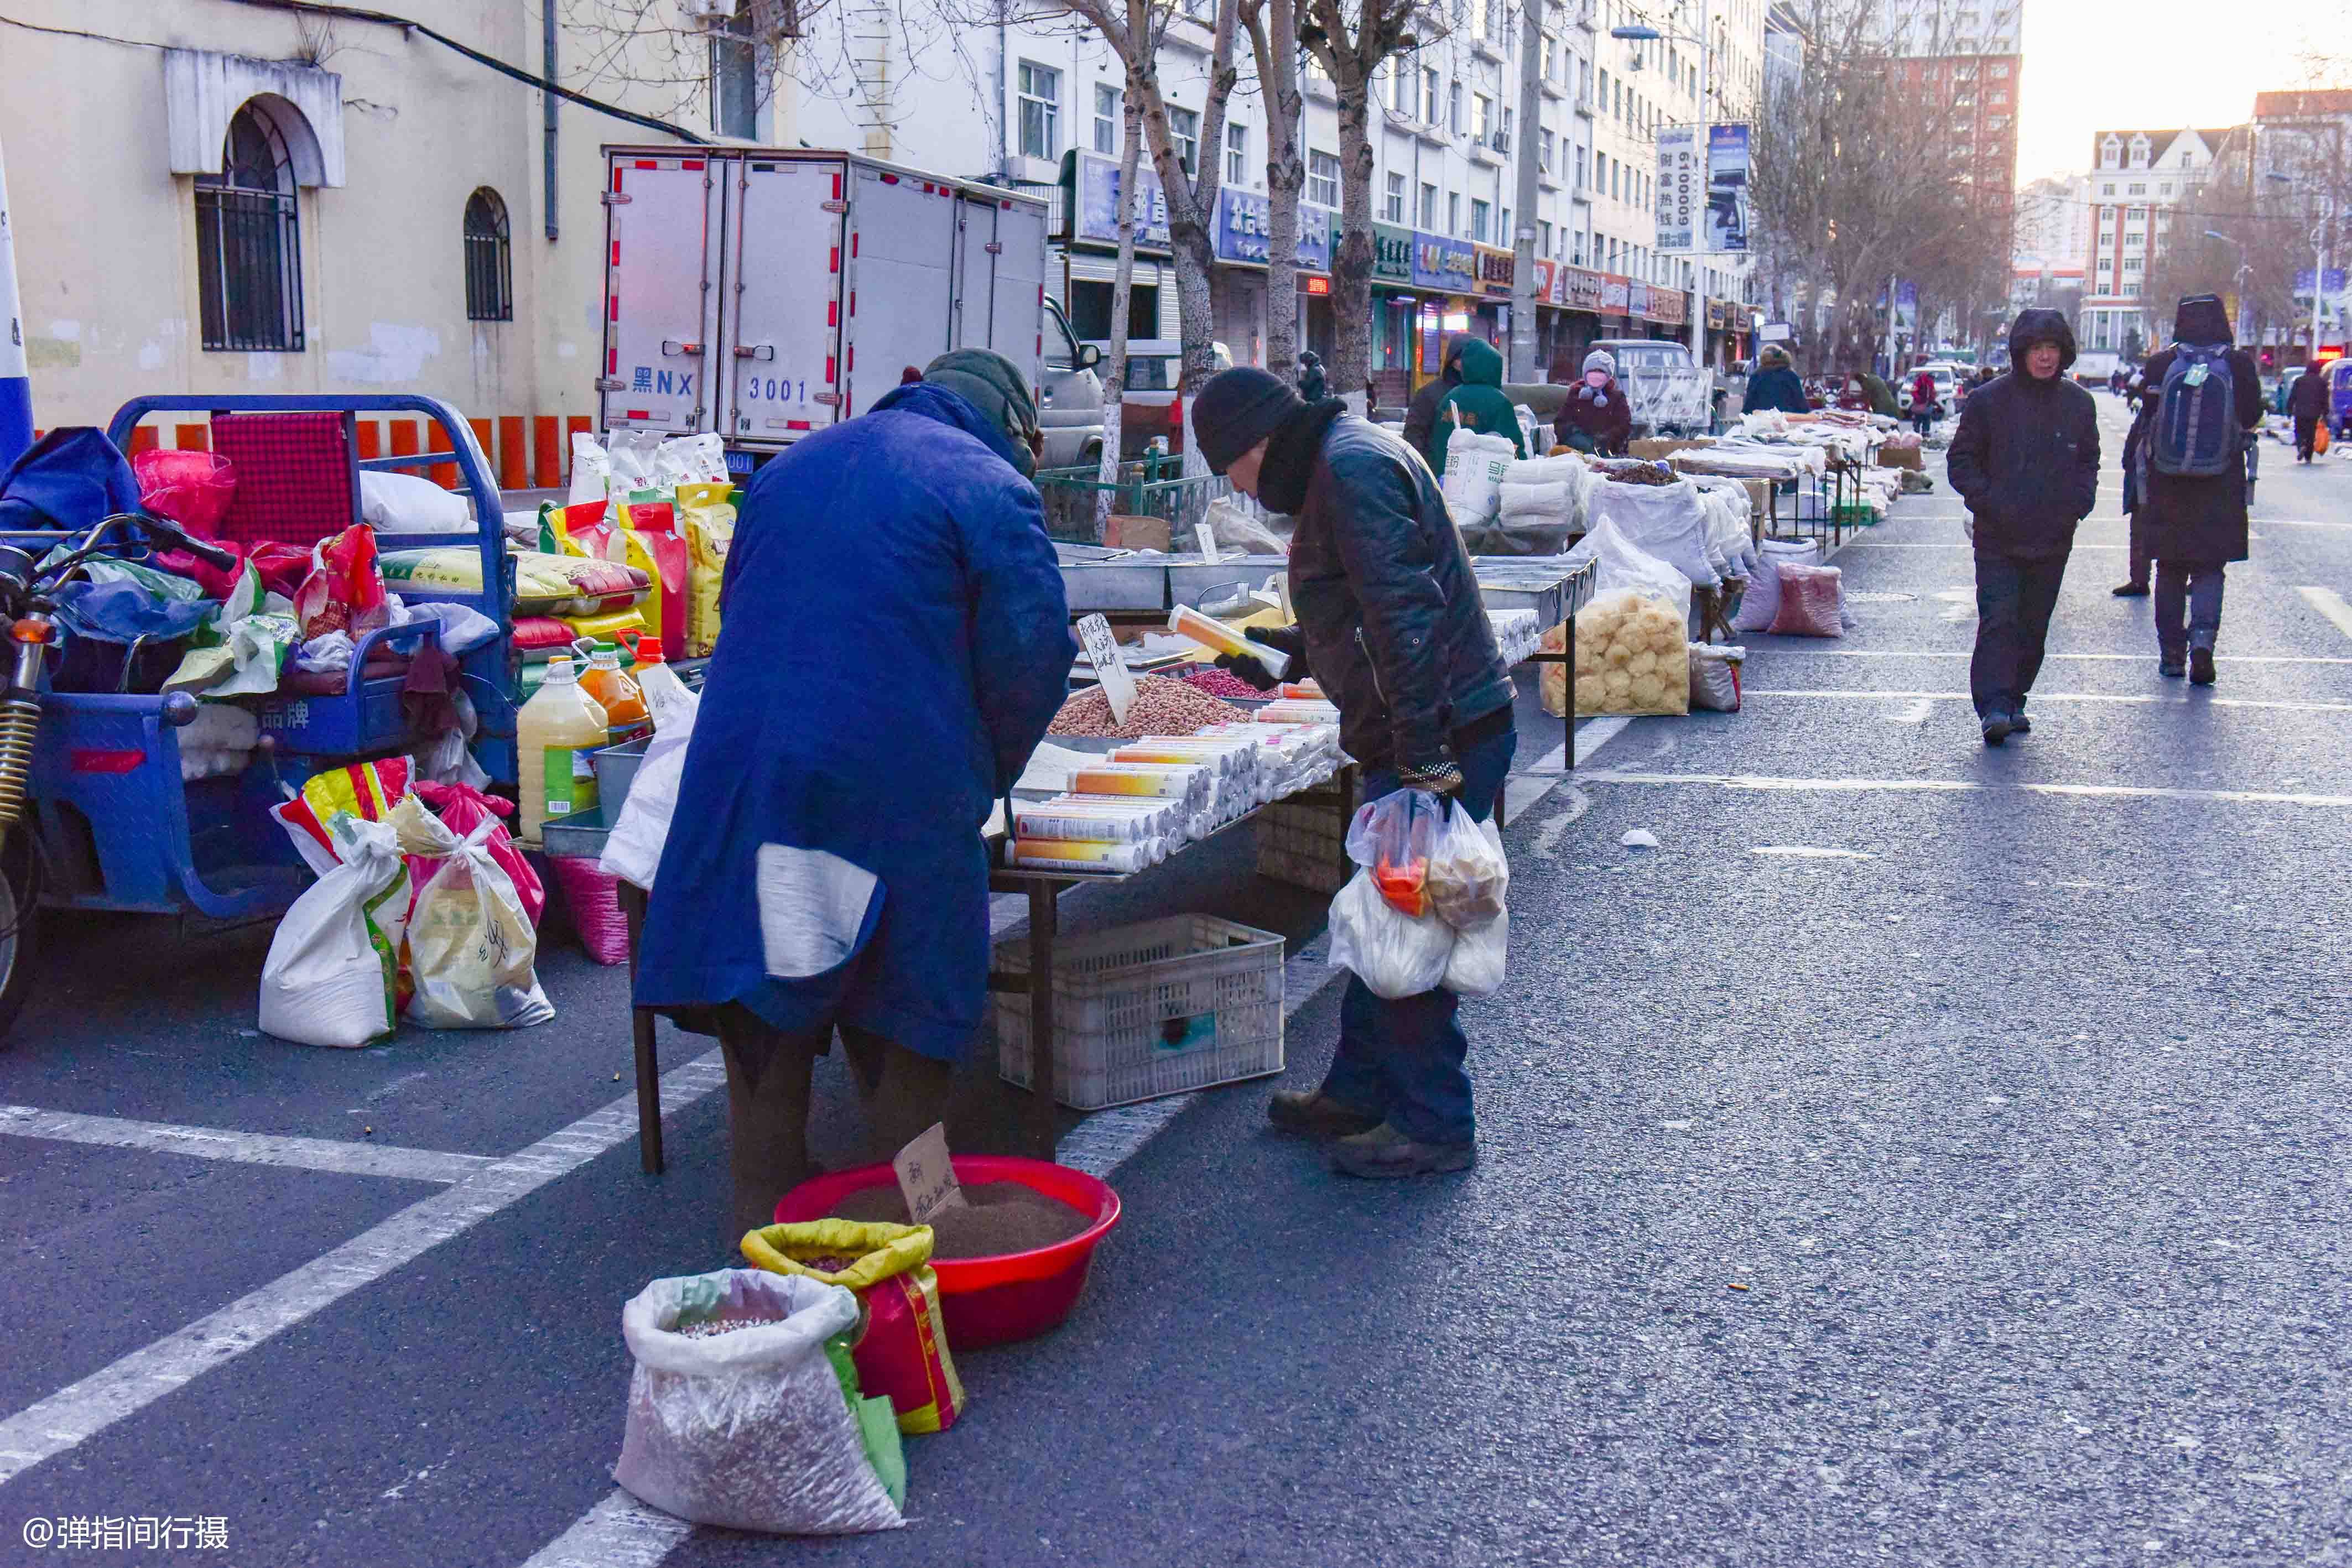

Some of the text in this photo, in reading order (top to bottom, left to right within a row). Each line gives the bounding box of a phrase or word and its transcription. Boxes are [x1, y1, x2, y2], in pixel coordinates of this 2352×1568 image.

[1678, 152, 1690, 226] 6100009
[633, 366, 805, 403] 黑NX 3001
[725, 454, 750, 470] 001
